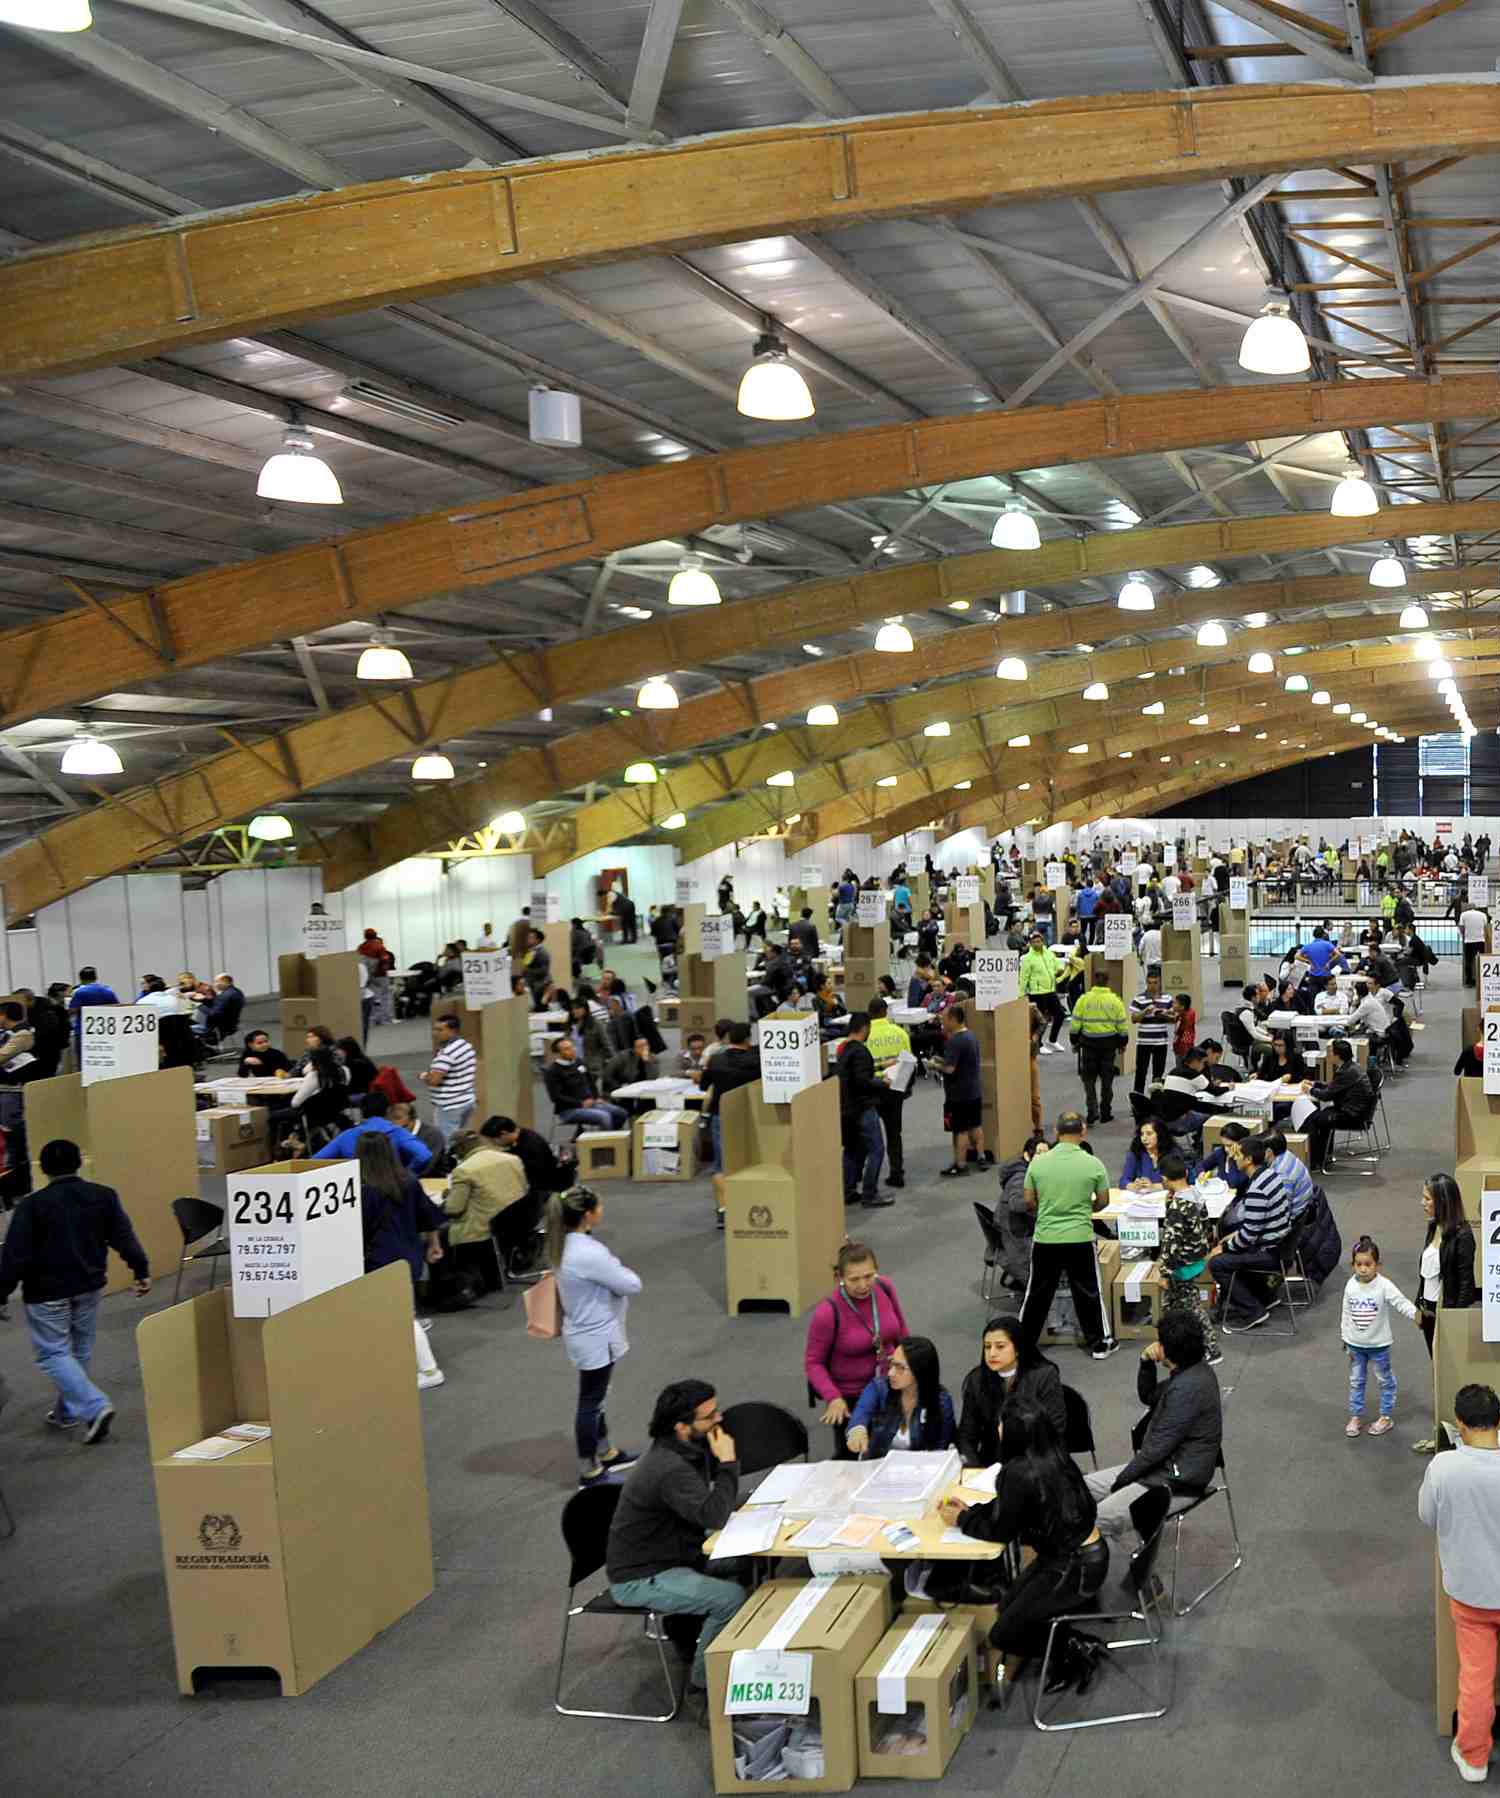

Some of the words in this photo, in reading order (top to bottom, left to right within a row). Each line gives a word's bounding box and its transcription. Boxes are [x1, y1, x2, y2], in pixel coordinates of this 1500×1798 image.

[1174, 898, 1190, 907] 266
[701, 921, 720, 933] 254
[1106, 919, 1127, 931] 255
[464, 959, 489, 974] 251
[978, 958, 1002, 973] 250
[85, 1016, 117, 1036] 238
[122, 1013, 157, 1035] 238
[763, 1030, 800, 1050] 239
[304, 1177, 357, 1222] 234
[233, 1190, 295, 1225] 234
[1120, 1231, 1140, 1240] MESA
[237, 1244, 296, 1255] 79.672.797
[239, 1271, 298, 1281] 79.674.548
[731, 1683, 773, 1702] MESA
[778, 1682, 804, 1700] 233
